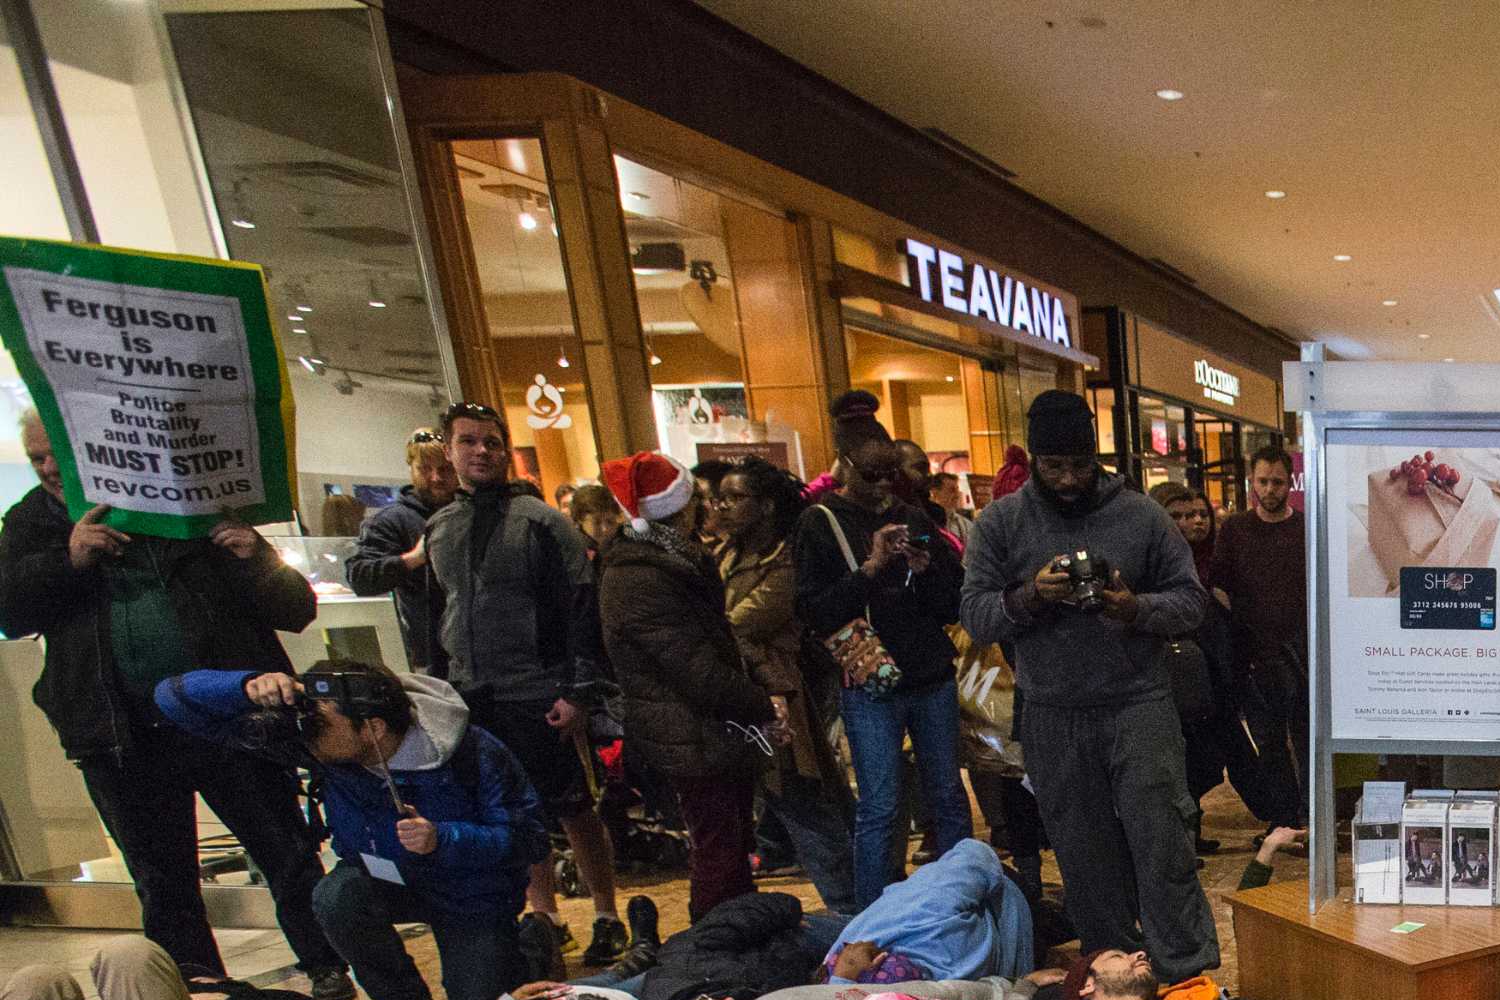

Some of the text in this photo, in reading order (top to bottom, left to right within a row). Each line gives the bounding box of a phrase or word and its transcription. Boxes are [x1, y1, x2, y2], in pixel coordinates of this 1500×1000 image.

[906, 238, 1071, 348] TEAVANA
[41, 289, 217, 334] Ferguson
[122, 331, 153, 354] is
[44, 340, 239, 381] Everywhere
[118, 391, 187, 413] Police
[110, 409, 202, 431] Brutality
[103, 427, 217, 450] and Murder
[84, 442, 244, 477] MUST STOP!
[92, 473, 252, 501] revcom.us
[1364, 646, 1406, 657] SMALL
[1410, 647, 1471, 658] PACKAGE.
[1476, 648, 1497, 658] BIG
